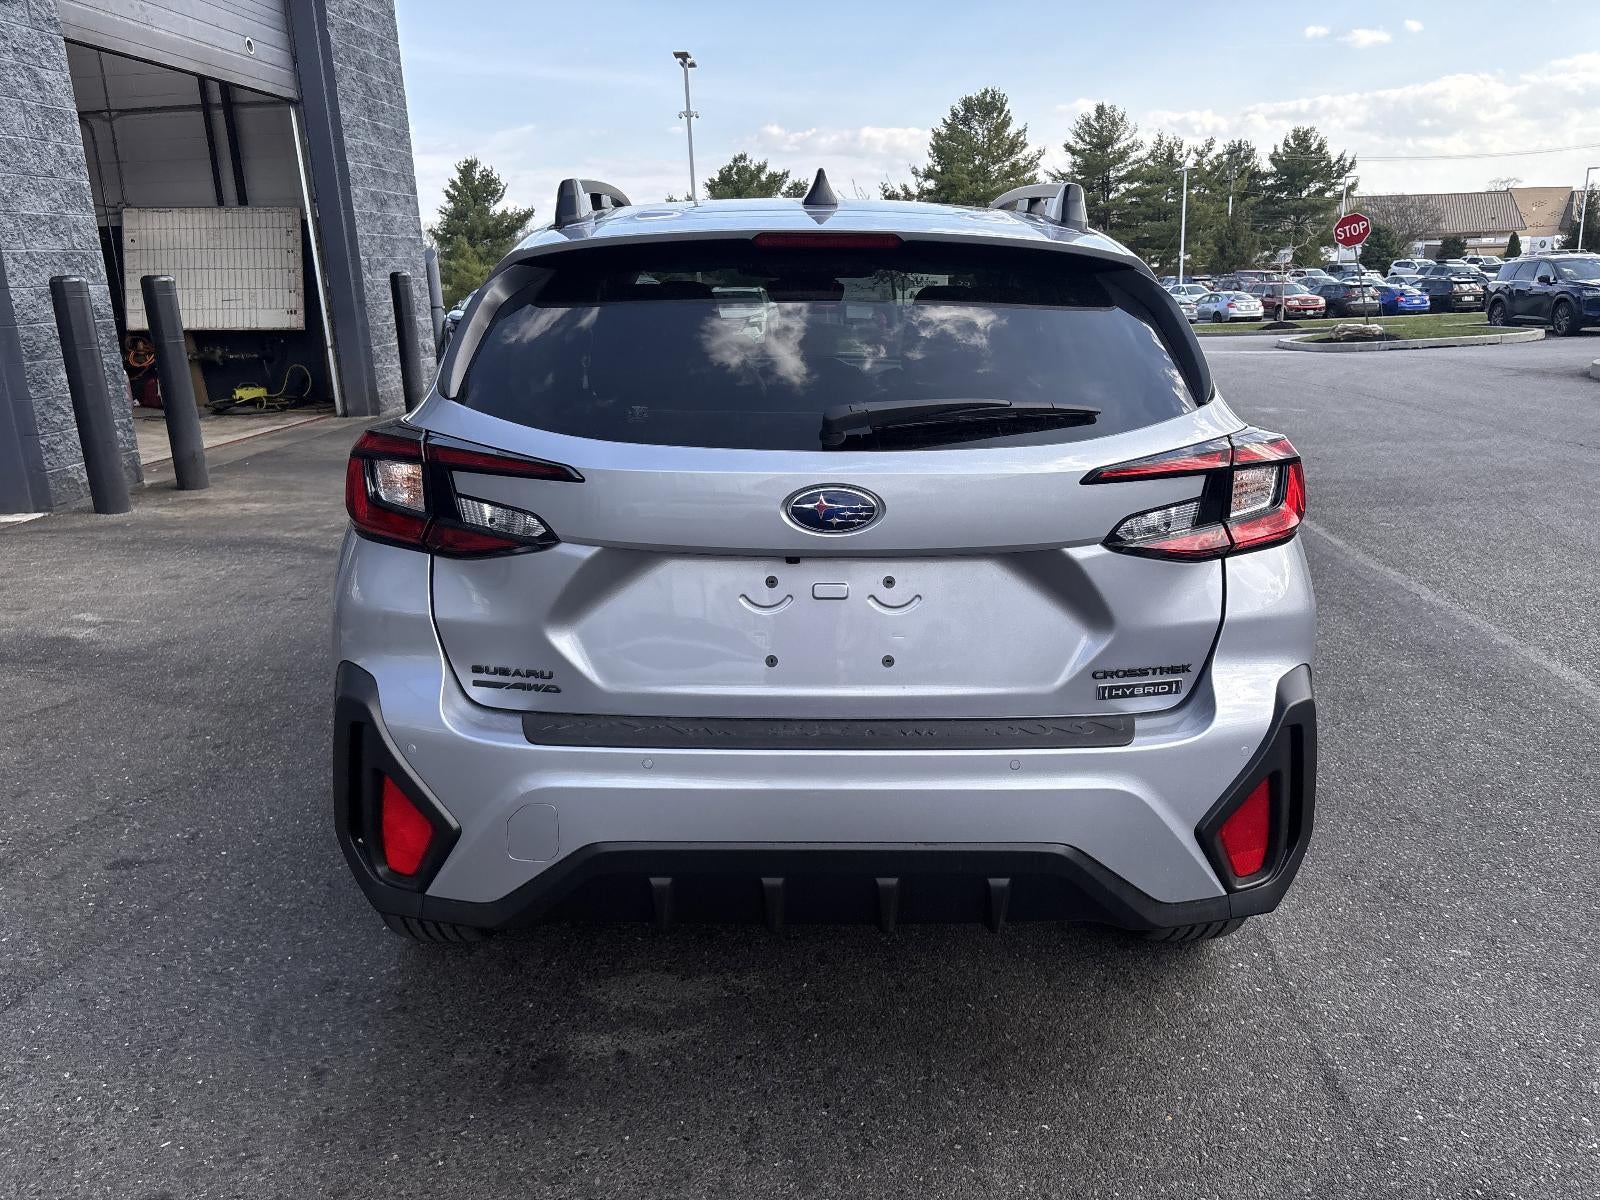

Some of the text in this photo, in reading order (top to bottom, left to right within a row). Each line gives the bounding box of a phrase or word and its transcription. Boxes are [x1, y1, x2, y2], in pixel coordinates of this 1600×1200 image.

[1337, 221, 1367, 240] STOP
[471, 664, 554, 680] SUBARU
[1091, 663, 1192, 680] CROSSTREK
[505, 682, 562, 693] AWD
[1112, 685, 1169, 696] HYBRID
